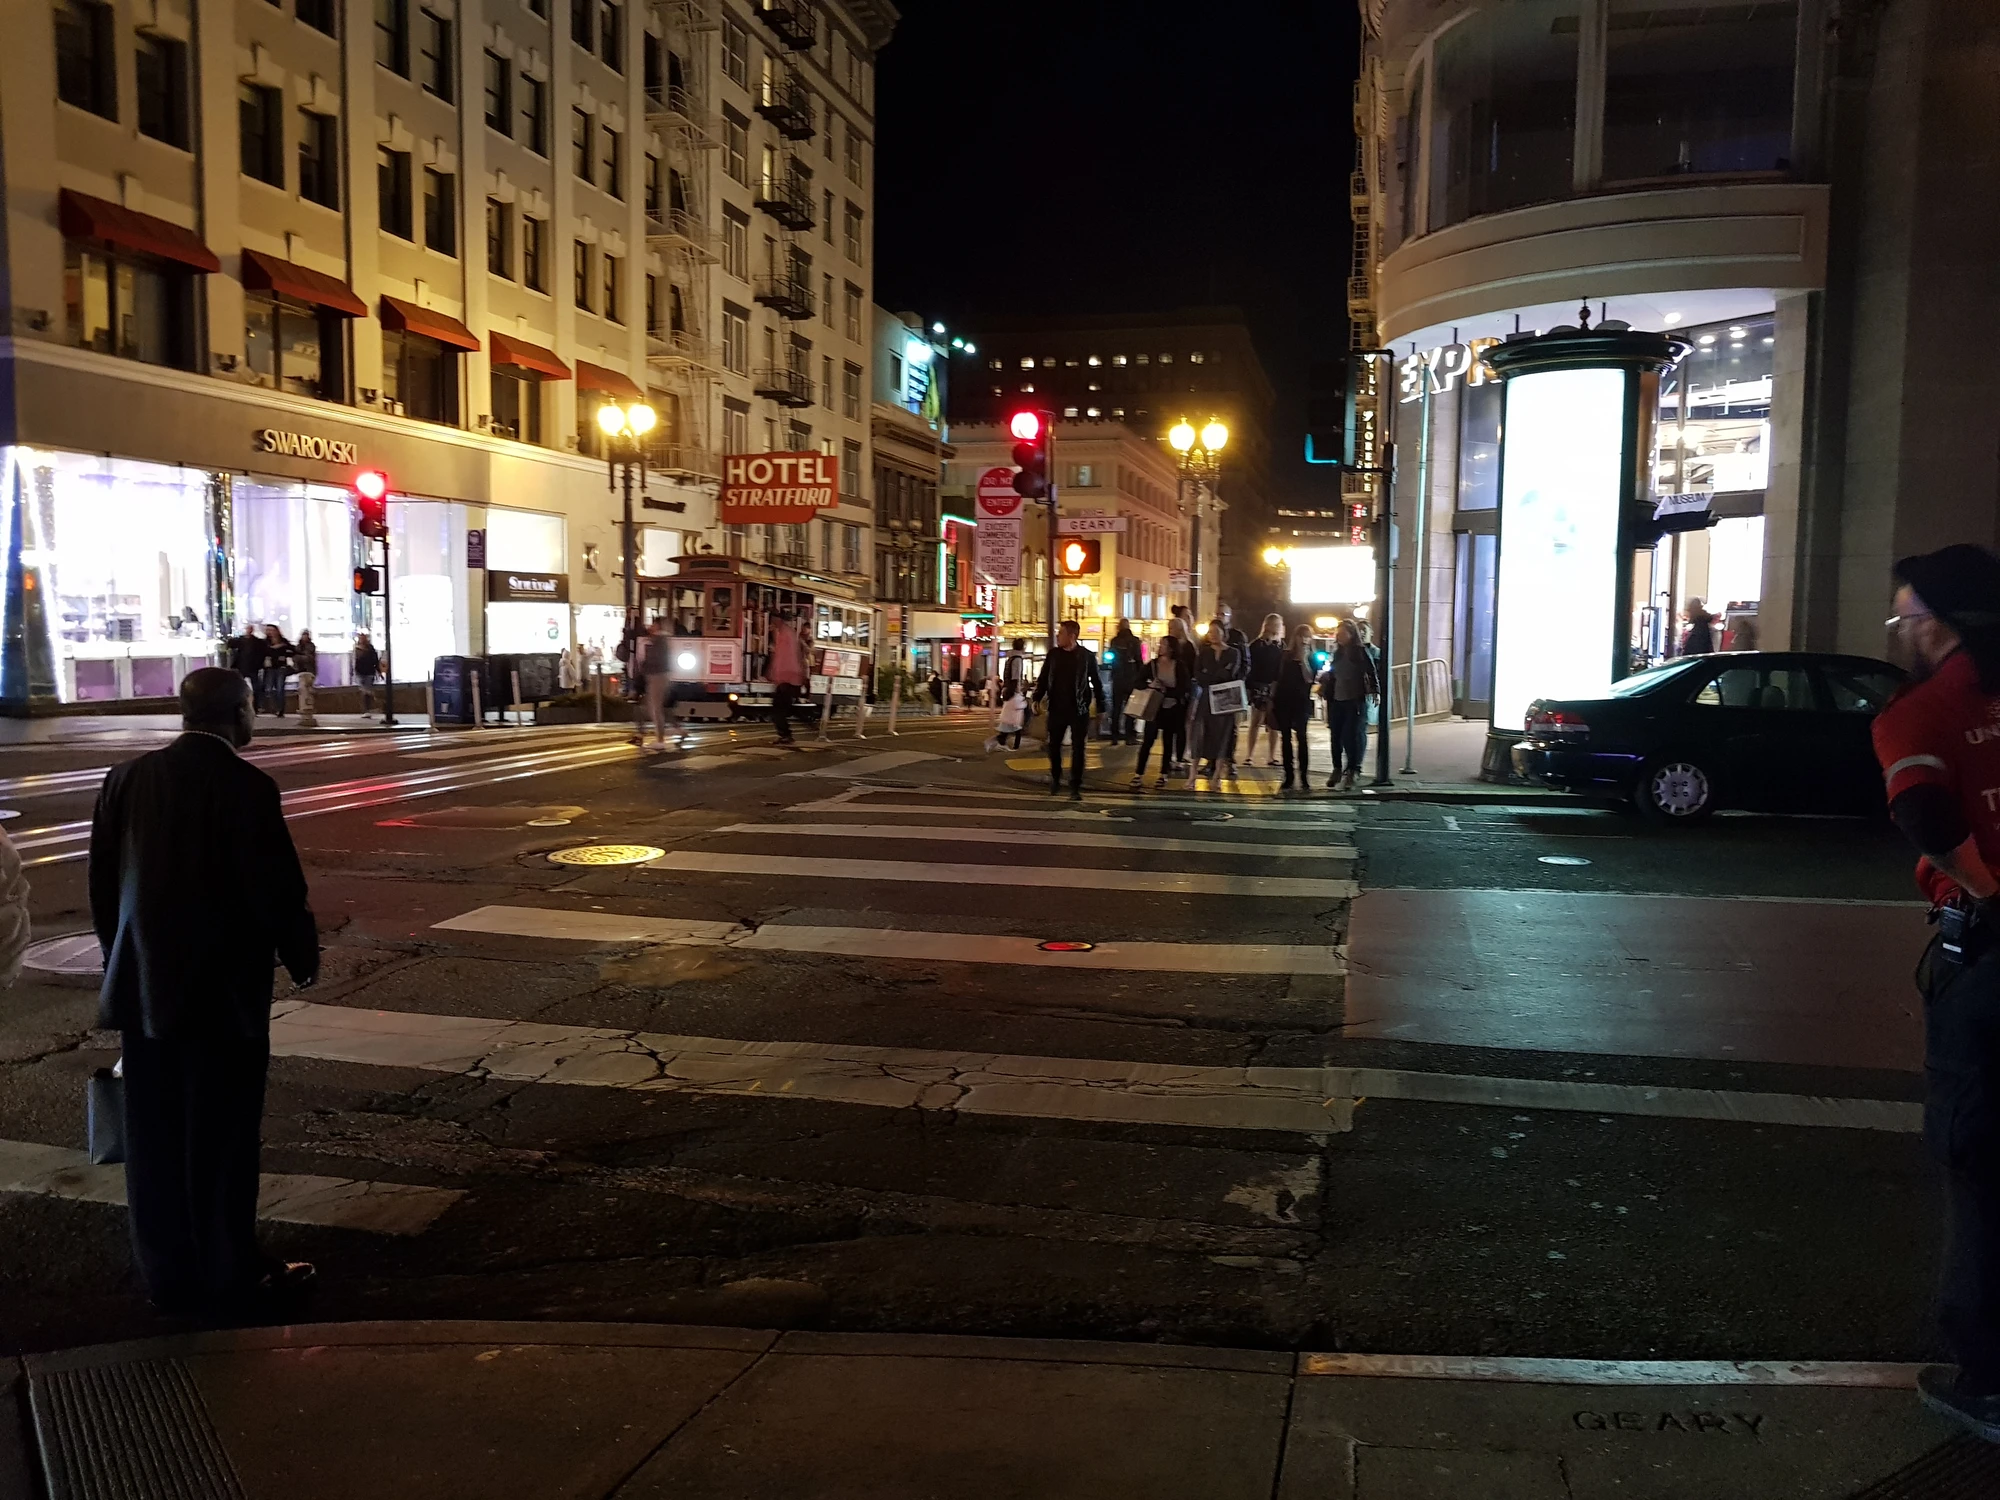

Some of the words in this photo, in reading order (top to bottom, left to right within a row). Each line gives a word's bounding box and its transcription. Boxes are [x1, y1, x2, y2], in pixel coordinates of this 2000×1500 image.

[263, 428, 358, 465] SWAROVSKI
[1362, 410, 1375, 492] FLORENCE
[726, 458, 832, 485] HOTEL
[1000, 476, 1013, 486] NO
[725, 487, 832, 507] STRATFORD
[986, 498, 1014, 507] ENTER
[1668, 492, 1707, 506] MUSEUM
[984, 522, 1013, 531] EXCEPT
[1069, 519, 1116, 530] GEARY
[978, 531, 1019, 540] COMMERCIAL
[1572, 1410, 1765, 1444] GEARY
